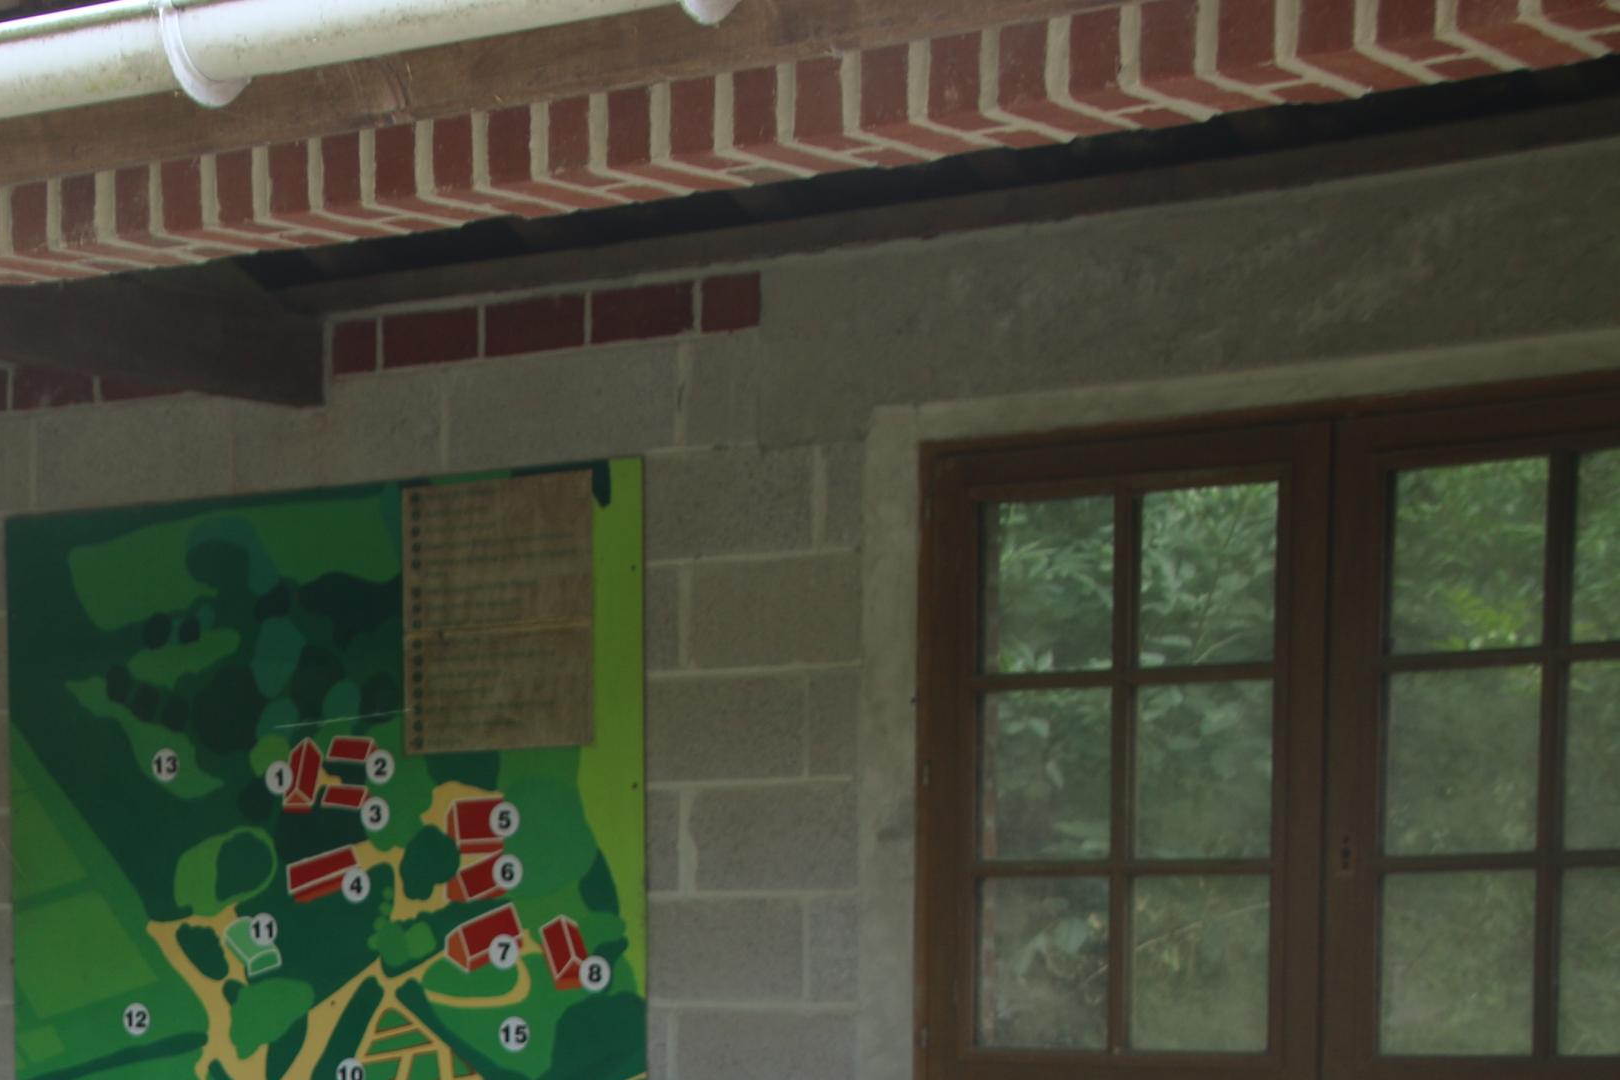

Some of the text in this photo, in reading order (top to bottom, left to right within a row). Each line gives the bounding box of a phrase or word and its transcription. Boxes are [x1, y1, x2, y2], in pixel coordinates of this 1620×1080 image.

[153, 755, 178, 775] 13
[252, 920, 275, 939] 11
[125, 1010, 148, 1029] 12
[502, 1024, 528, 1044] 15
